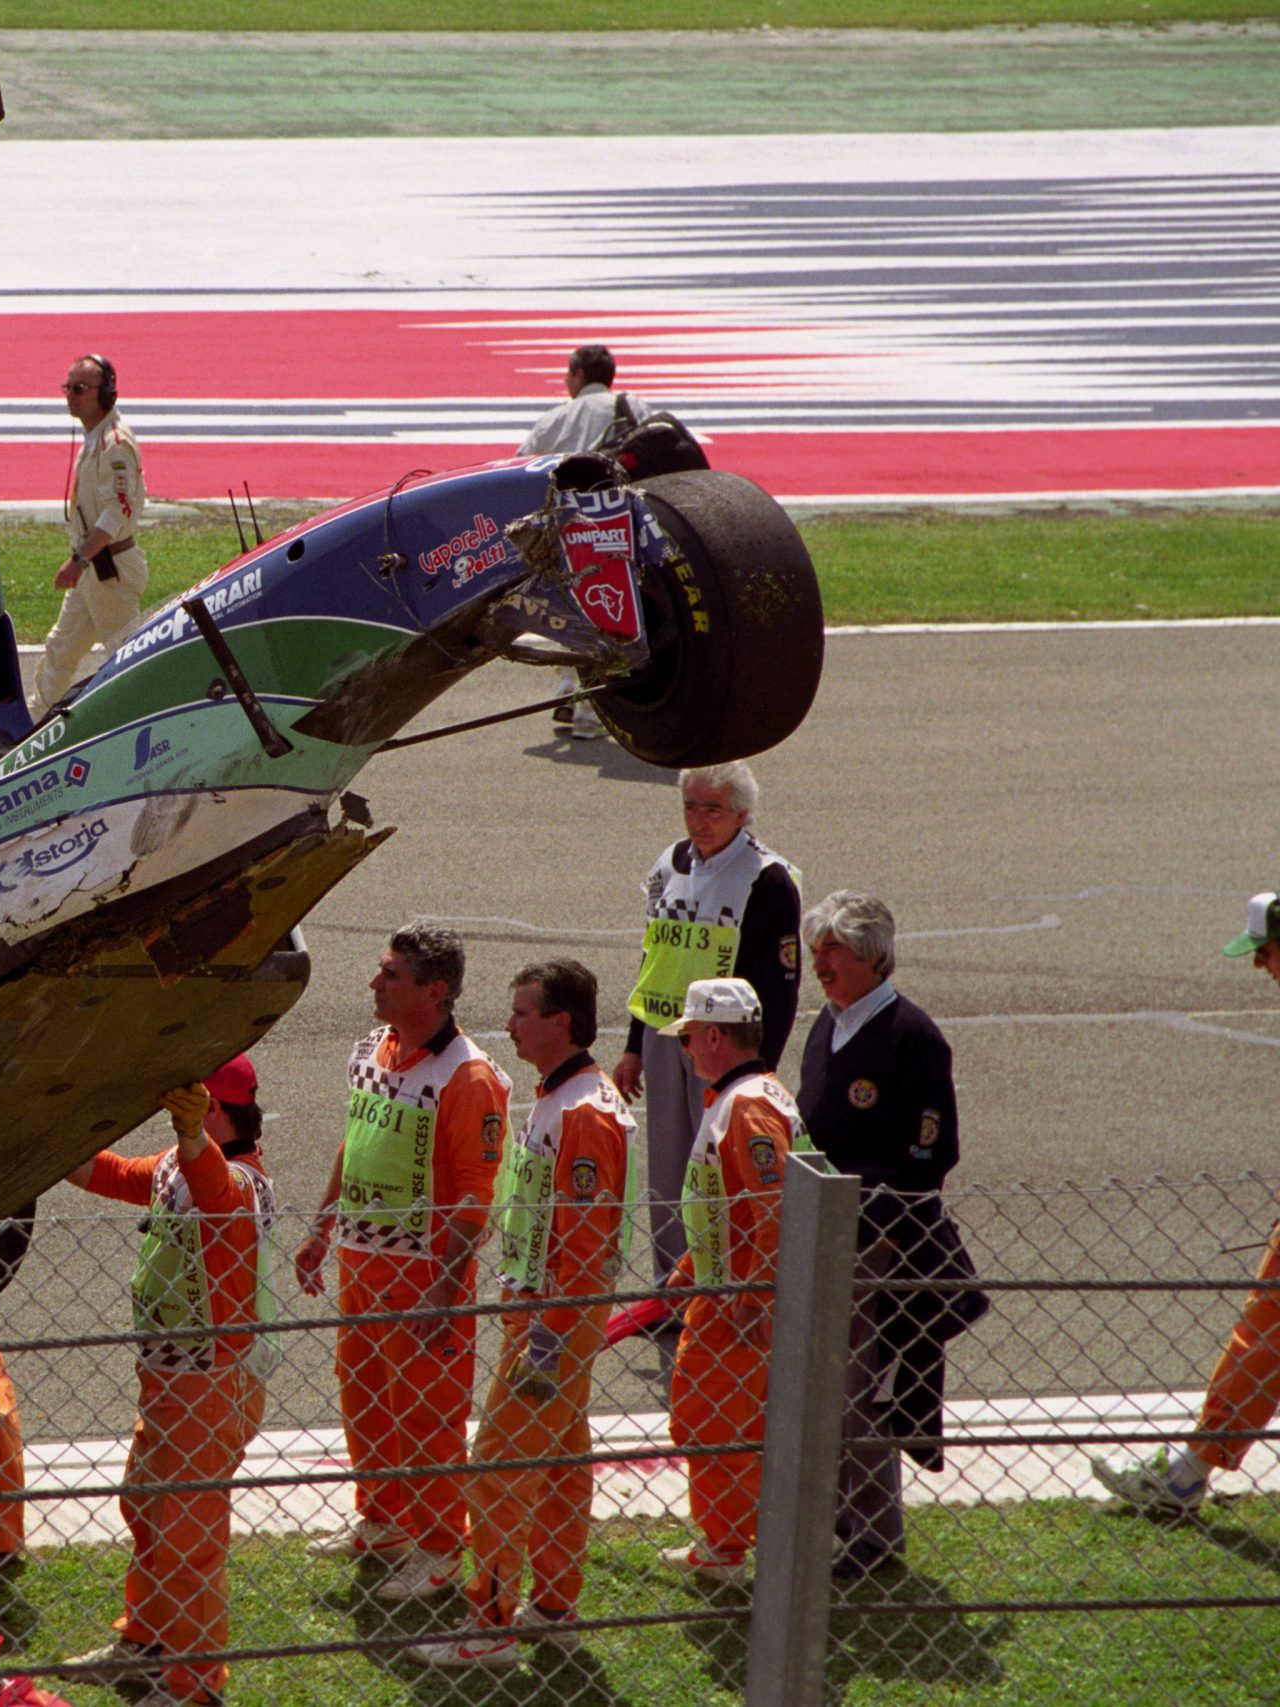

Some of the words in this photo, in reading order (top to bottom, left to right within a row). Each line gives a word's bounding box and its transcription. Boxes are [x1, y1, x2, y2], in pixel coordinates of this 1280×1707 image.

[566, 529, 628, 545] UNIPART
[149, 739, 171, 762] ASR
[4, 789, 64, 829] INSTRUMENTS
[651, 924, 711, 950] 30813
[349, 1093, 404, 1134] 31631
[414, 1115, 430, 1168] ACCESS
